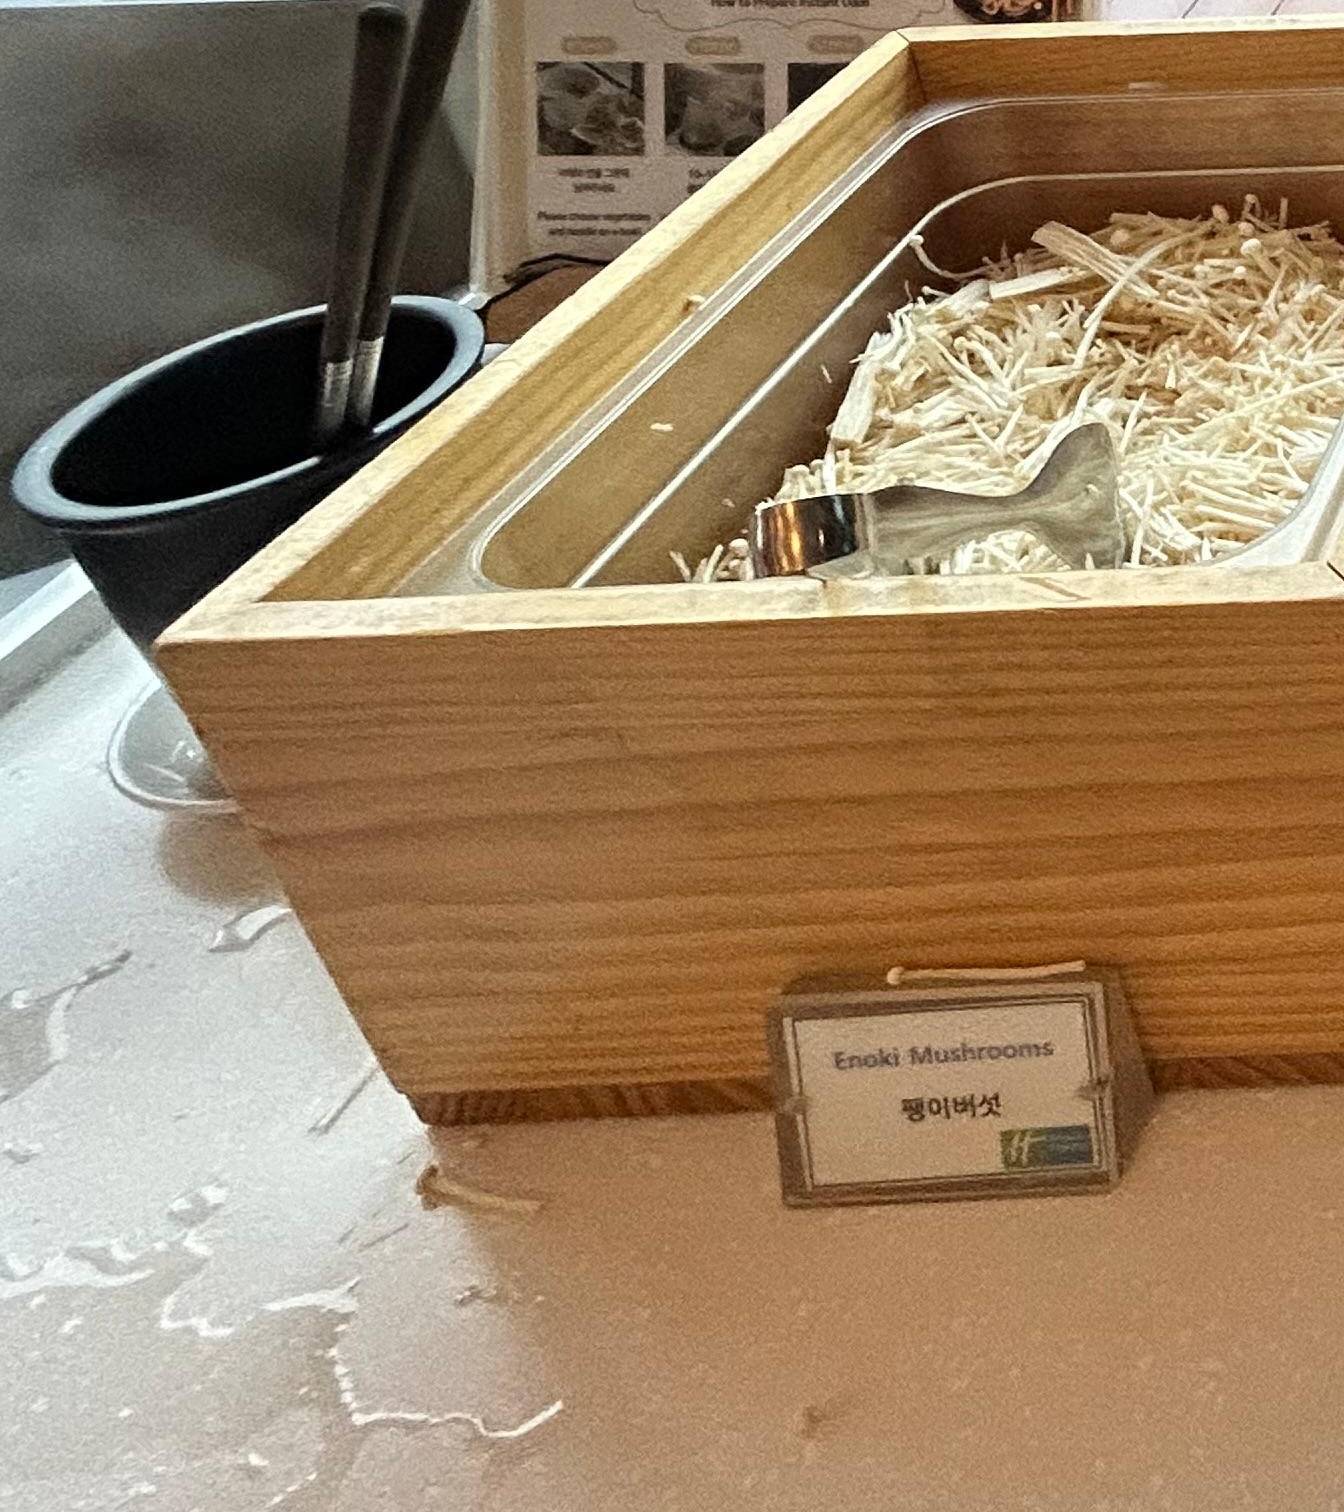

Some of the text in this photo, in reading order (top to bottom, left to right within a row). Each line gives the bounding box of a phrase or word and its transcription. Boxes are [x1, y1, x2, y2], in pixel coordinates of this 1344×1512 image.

[832, 1040, 1055, 1071] Enoki Mushrooms
[901, 1091, 1002, 1123] 팽이버섯
